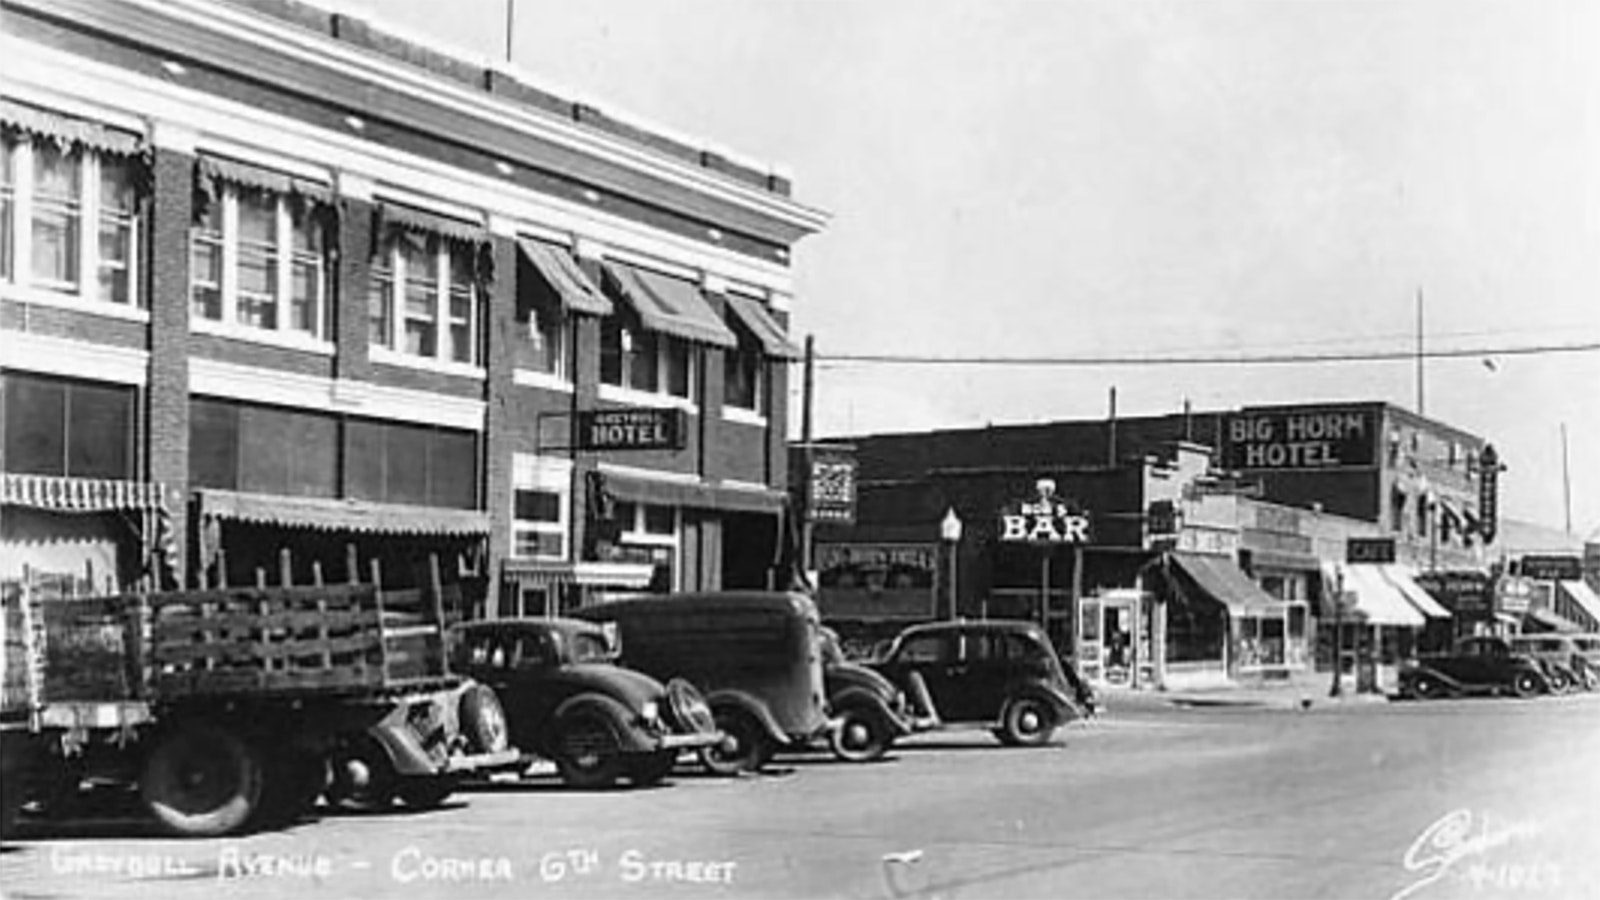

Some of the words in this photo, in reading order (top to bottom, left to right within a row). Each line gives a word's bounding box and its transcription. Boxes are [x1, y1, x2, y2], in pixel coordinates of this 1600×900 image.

[591, 424, 666, 445] HOTEL
[1230, 417, 1272, 442] BIG
[1287, 413, 1364, 440] HORN
[1246, 441, 1340, 466] HOTEL
[1002, 515, 1089, 541] BAR
